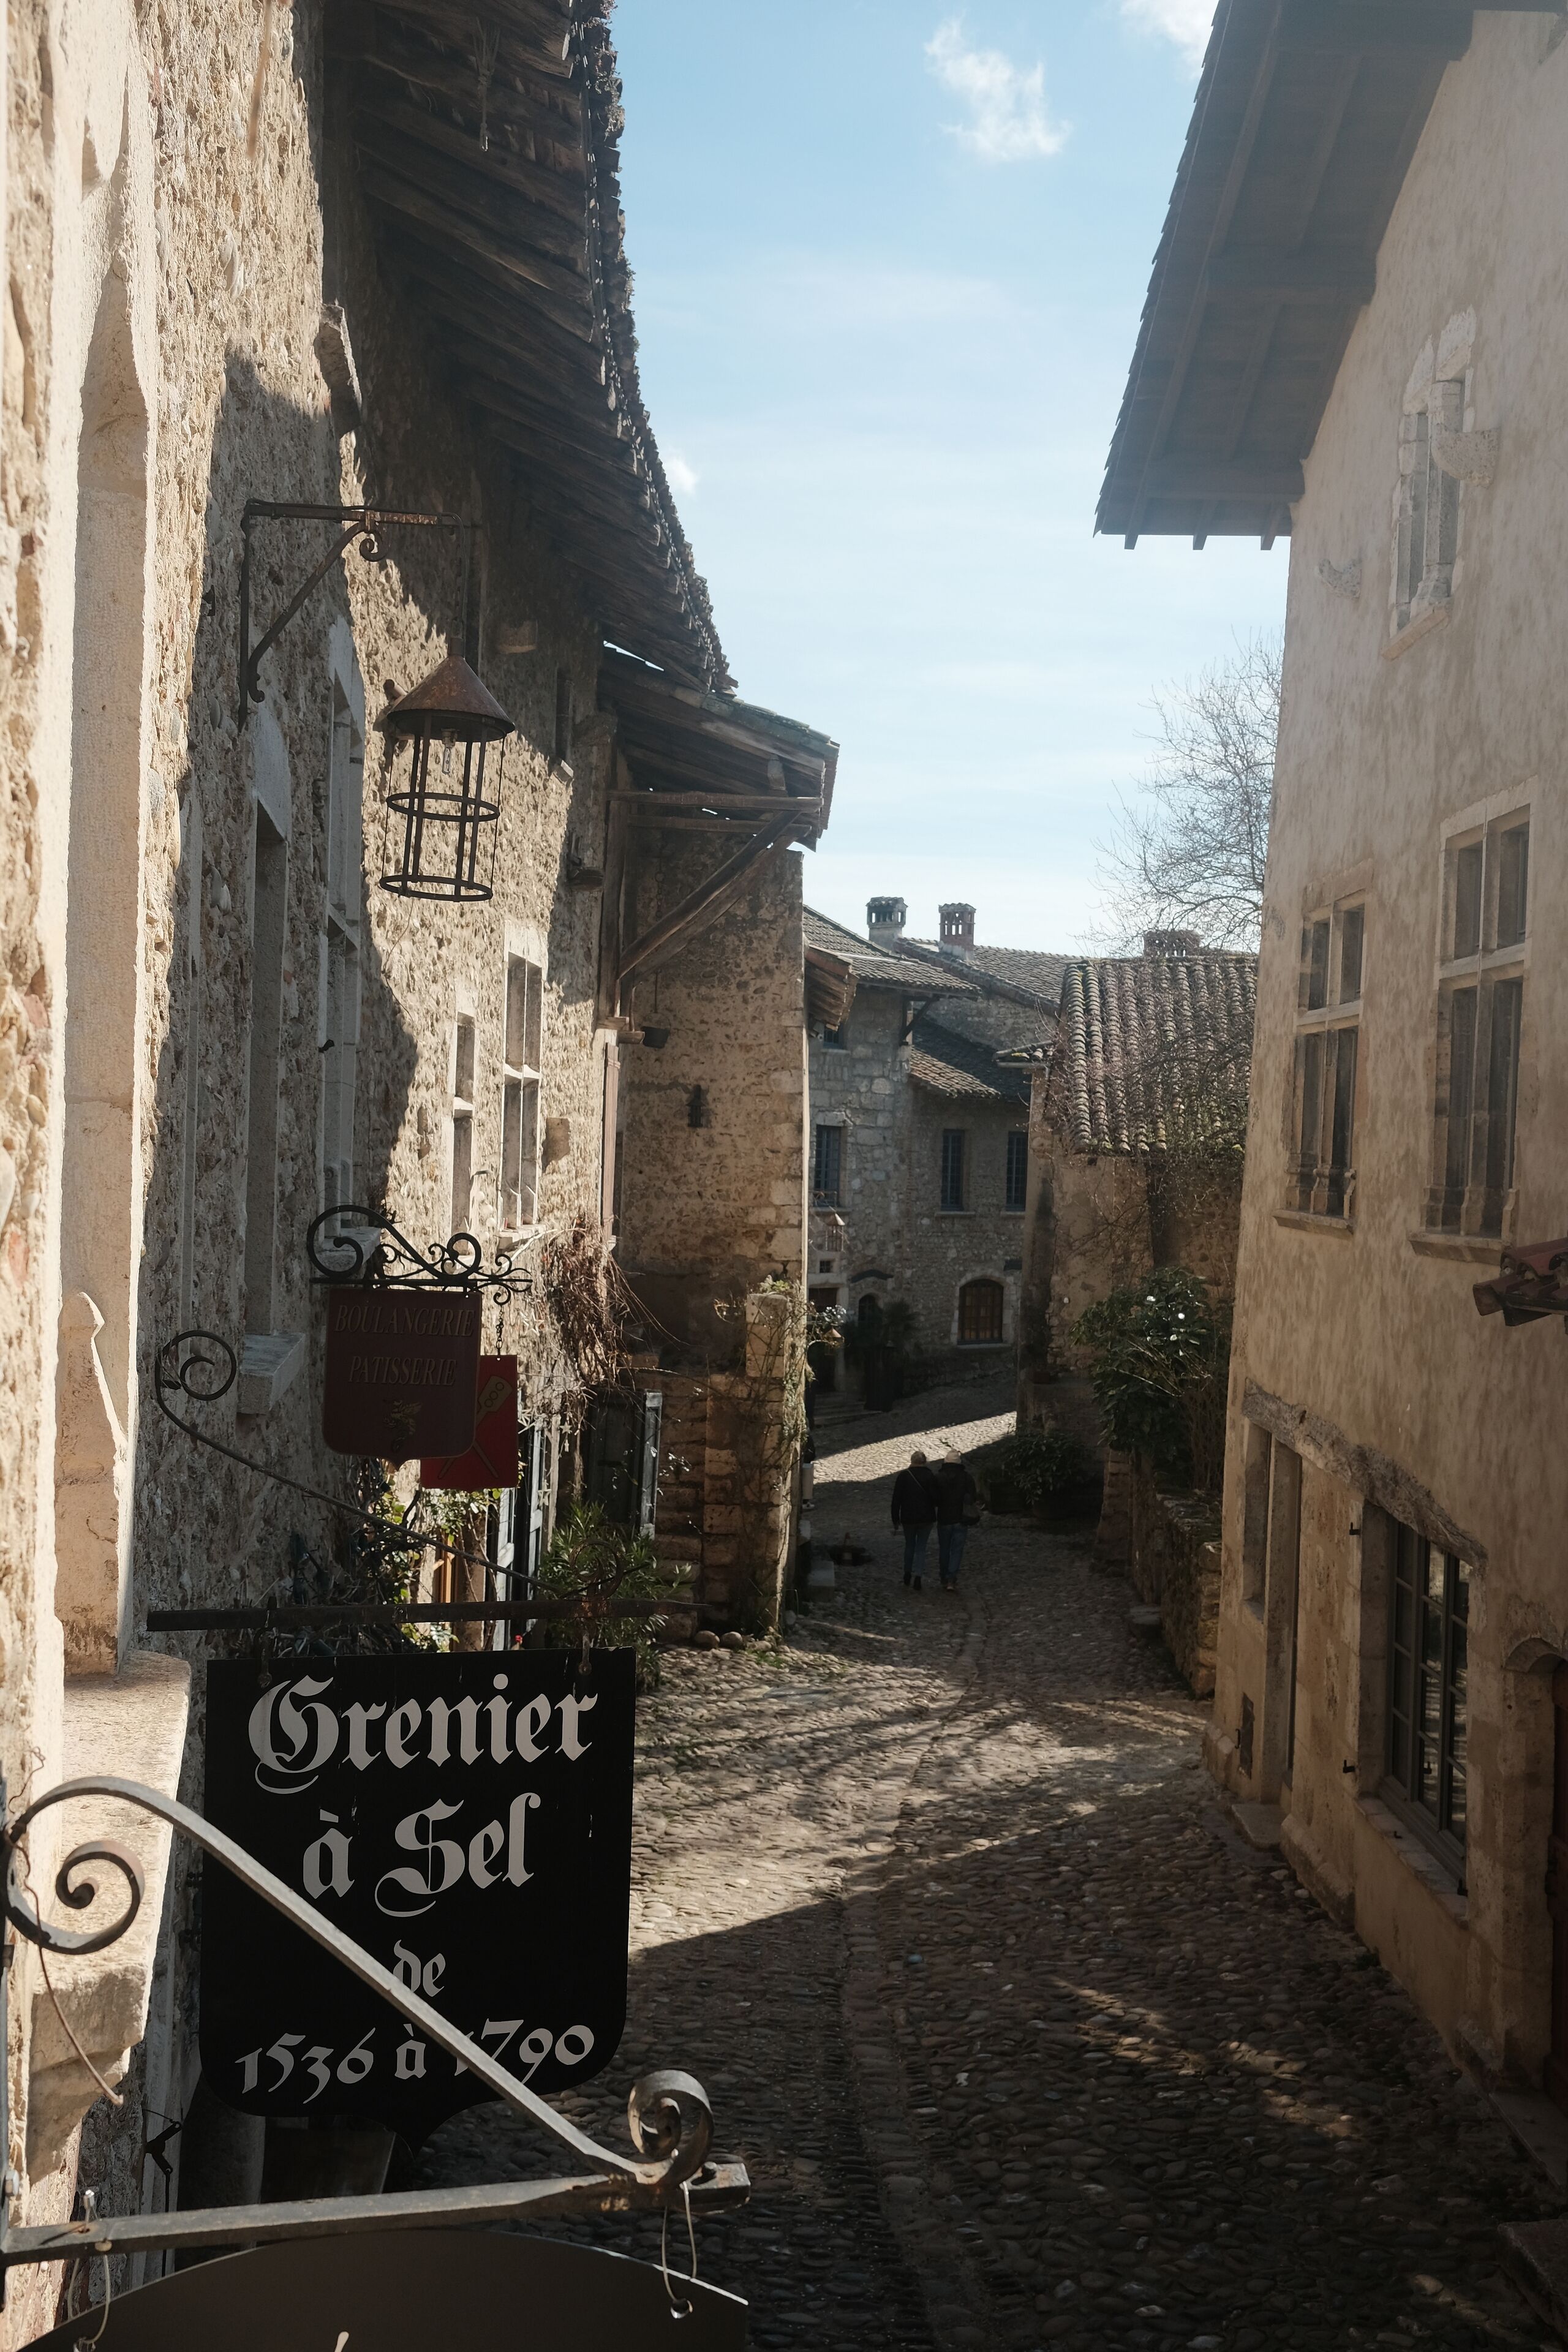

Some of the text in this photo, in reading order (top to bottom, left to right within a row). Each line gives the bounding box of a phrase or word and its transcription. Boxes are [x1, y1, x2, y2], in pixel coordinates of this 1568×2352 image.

[334, 1304, 475, 1337] BOULANGERIE
[348, 1355, 457, 1386] PATISSERIE
[249, 1673, 598, 1795] Grenier
[303, 1792, 541, 1917] à Sel
[393, 1939, 447, 1997] de
[235, 2027, 376, 2105] 1536
[394, 2023, 427, 2079] à
